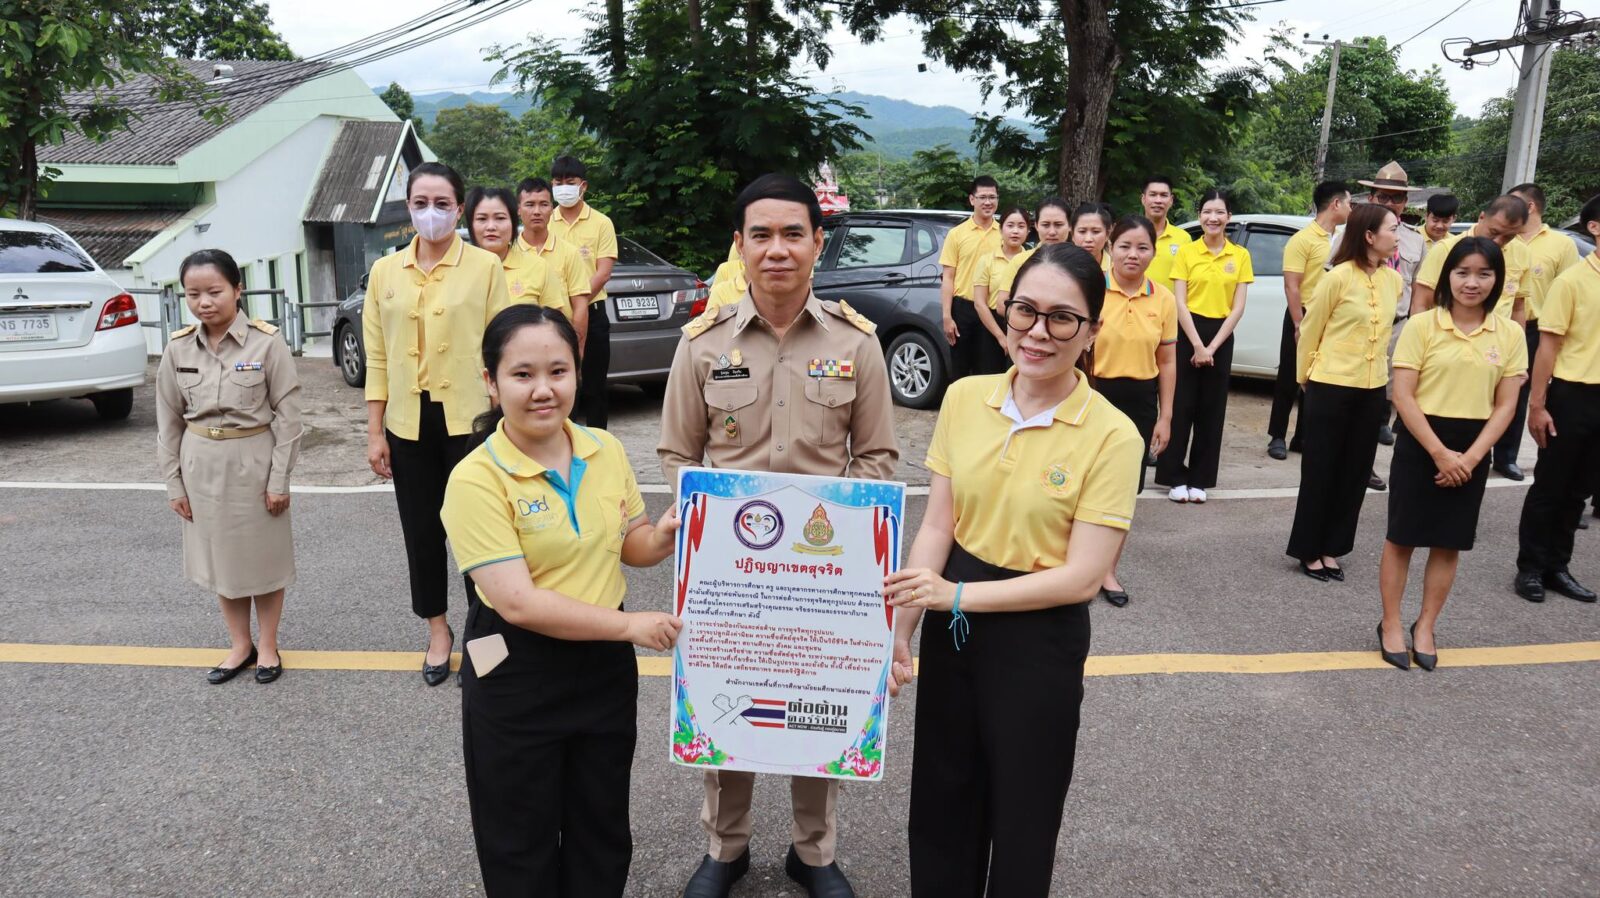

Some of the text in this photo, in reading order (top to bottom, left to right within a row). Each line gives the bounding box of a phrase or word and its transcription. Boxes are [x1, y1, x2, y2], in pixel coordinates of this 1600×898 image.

[636, 298, 656, 307] 9232
[21, 319, 50, 329] 7735
[735, 557, 843, 579] ปฏิญญาเขตสุจริต
[858, 600, 881, 608] ด้วยการ
[748, 611, 761, 619] ดังนี้
[788, 698, 848, 718] ต่อต้าน
